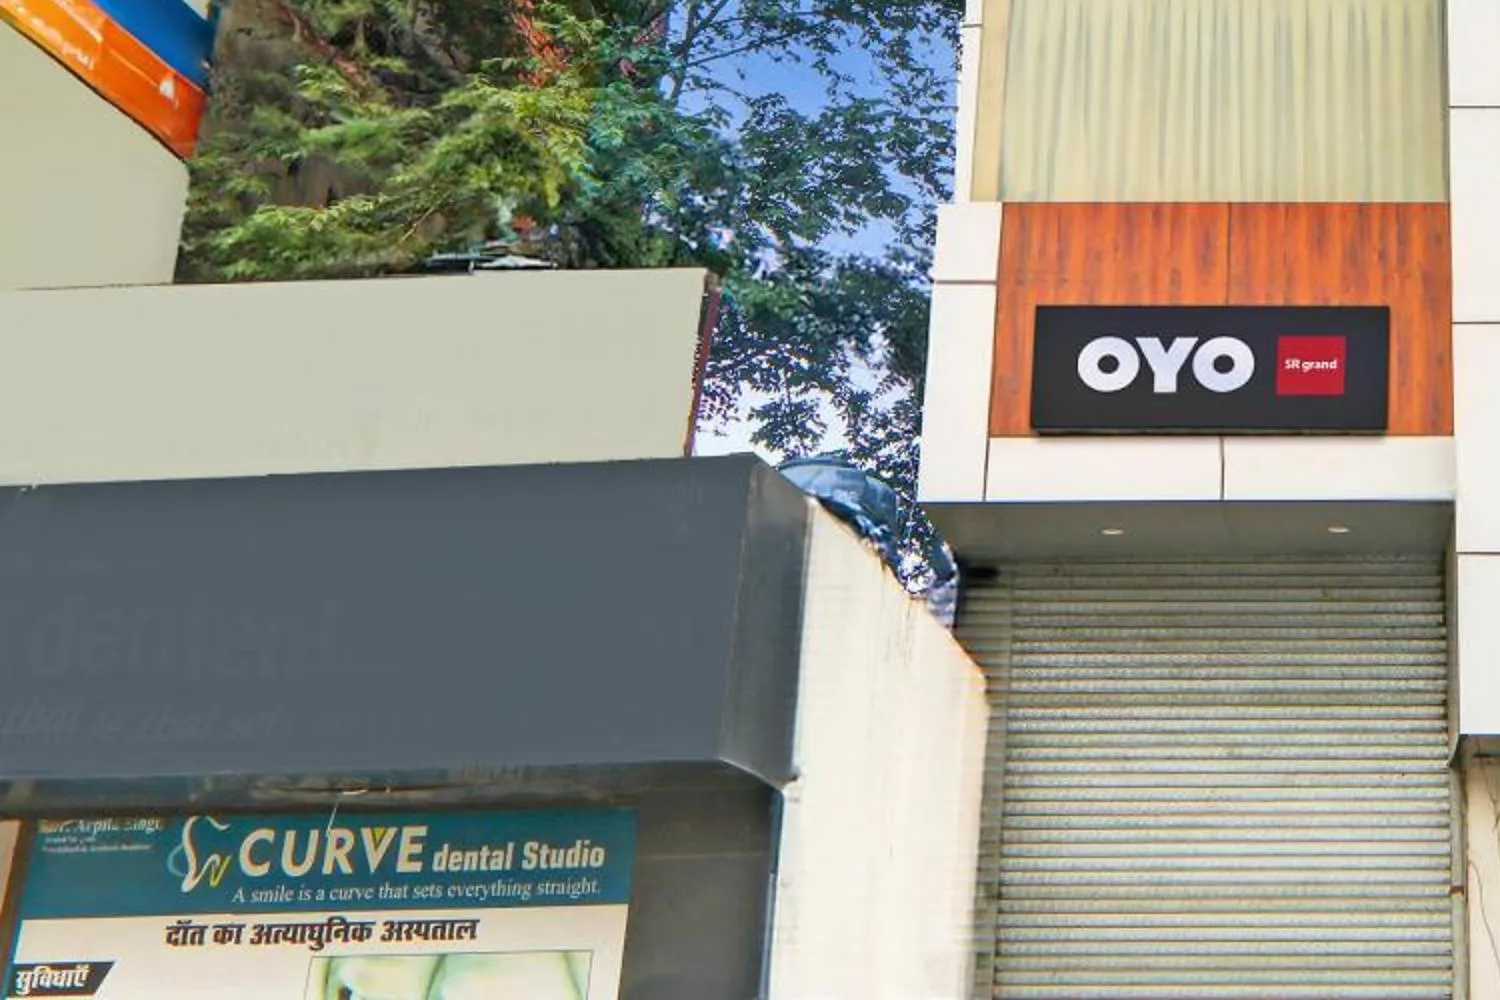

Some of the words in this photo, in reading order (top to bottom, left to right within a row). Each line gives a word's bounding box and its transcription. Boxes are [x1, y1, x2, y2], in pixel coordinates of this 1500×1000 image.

[1077, 336, 1255, 393] OYO
[1285, 359, 1300, 369] SR
[1302, 359, 1337, 372] grand
[238, 826, 429, 877] CURVE
[432, 843, 515, 873] dental
[522, 839, 605, 871] Studio
[231, 886, 246, 904] A
[251, 884, 295, 903] smile
[299, 884, 312, 902] is
[316, 888, 326, 901] a
[329, 886, 375, 901] curve
[379, 881, 409, 900] that
[413, 882, 443, 899] sets
[447, 877, 532, 901] everything
[537, 875, 602, 899] straight.
[212, 923, 246, 945] का
[250, 915, 377, 951] अत्याधुनिक
[380, 917, 480, 942] अस्पताल
